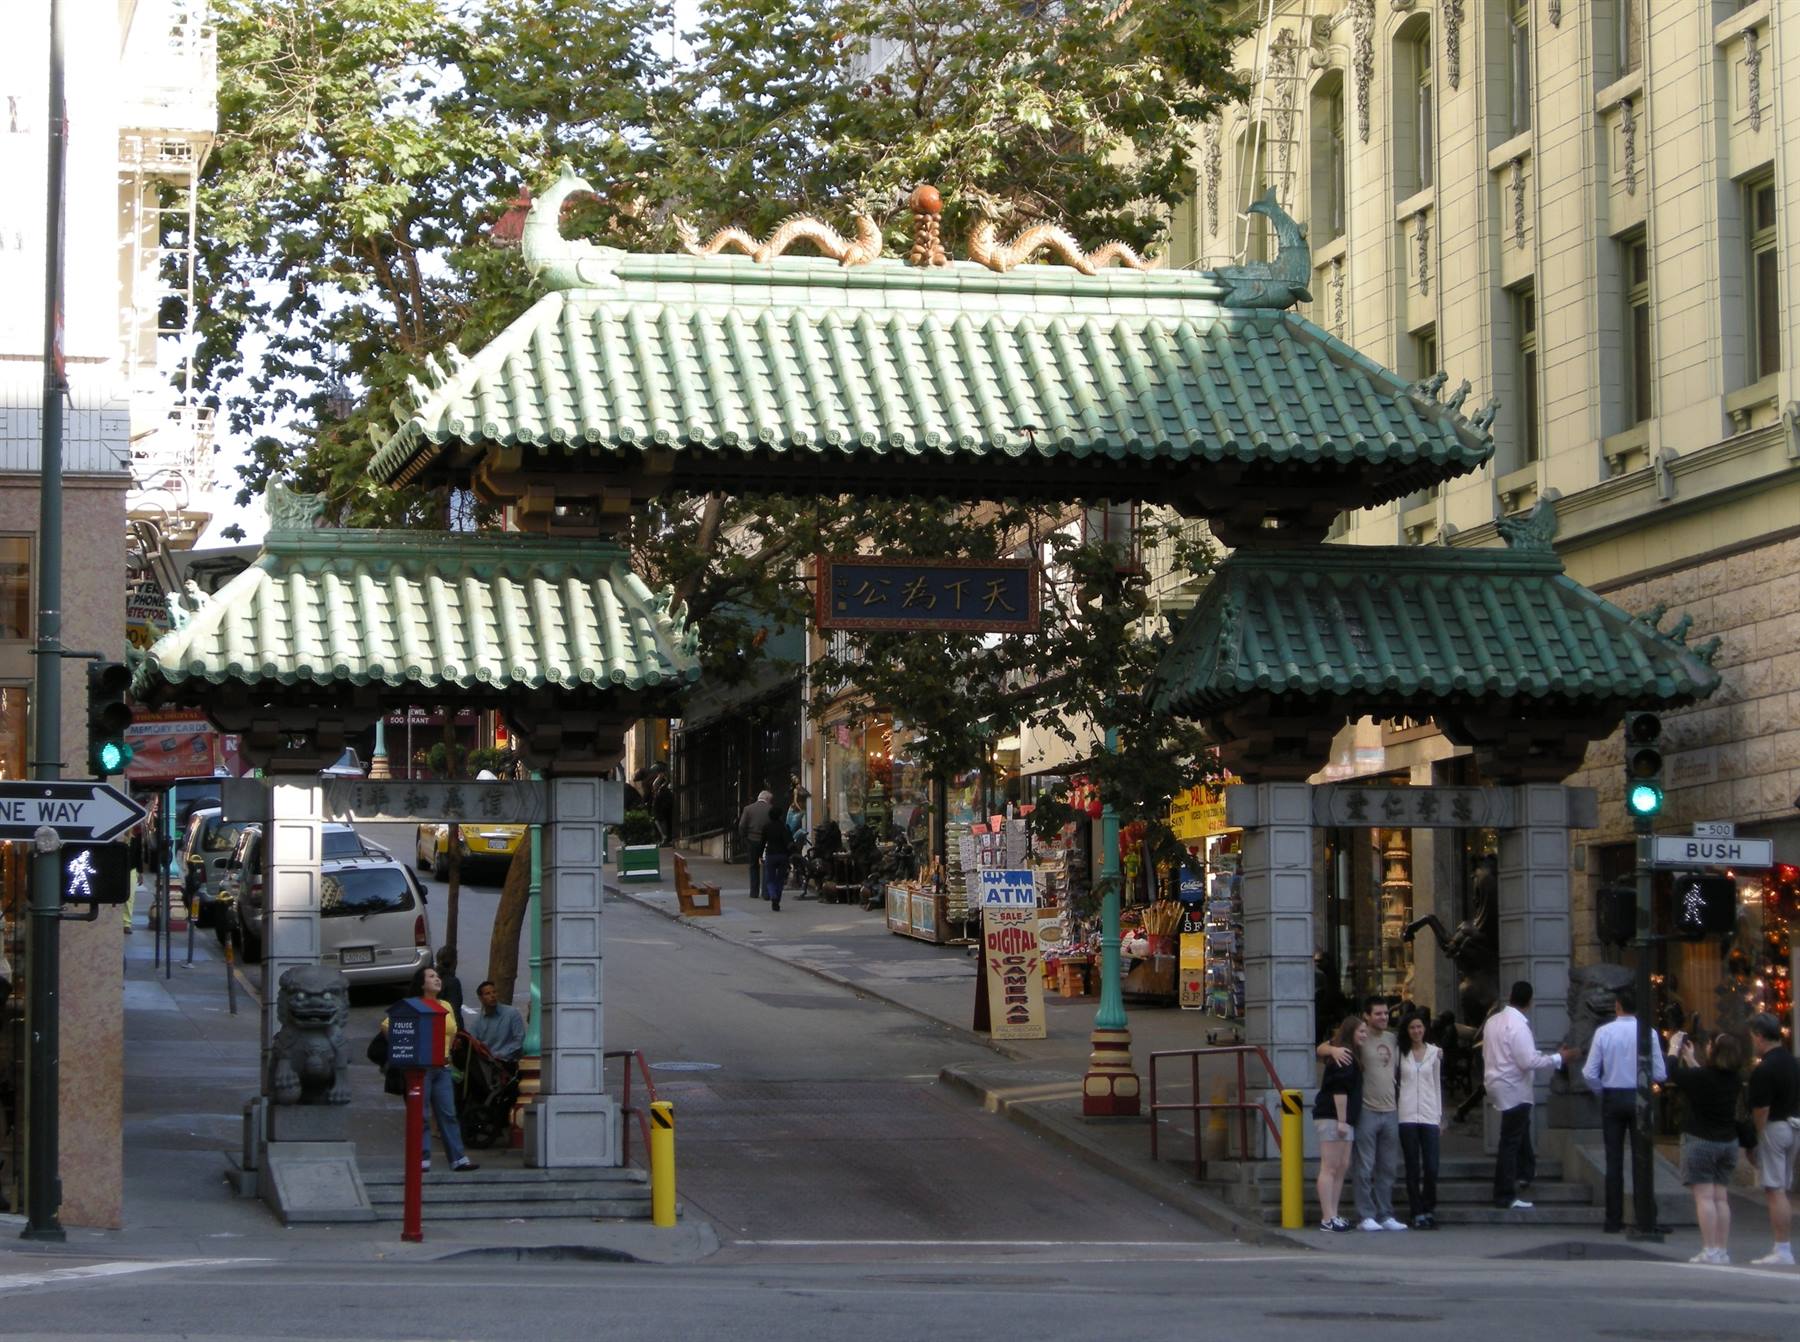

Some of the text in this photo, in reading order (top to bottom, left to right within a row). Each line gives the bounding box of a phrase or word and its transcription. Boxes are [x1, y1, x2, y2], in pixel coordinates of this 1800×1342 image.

[130, 723, 208, 734] MEMORY CARDS
[38, 802, 84, 822] WAY
[1709, 825, 1731, 835] 500
[1686, 842, 1741, 860] BUSH
[986, 888, 1034, 904] ATM
[1000, 912, 1023, 921] SALE
[987, 927, 1038, 955] DIGITAL
[1002, 955, 1030, 1025] CAMERAS
